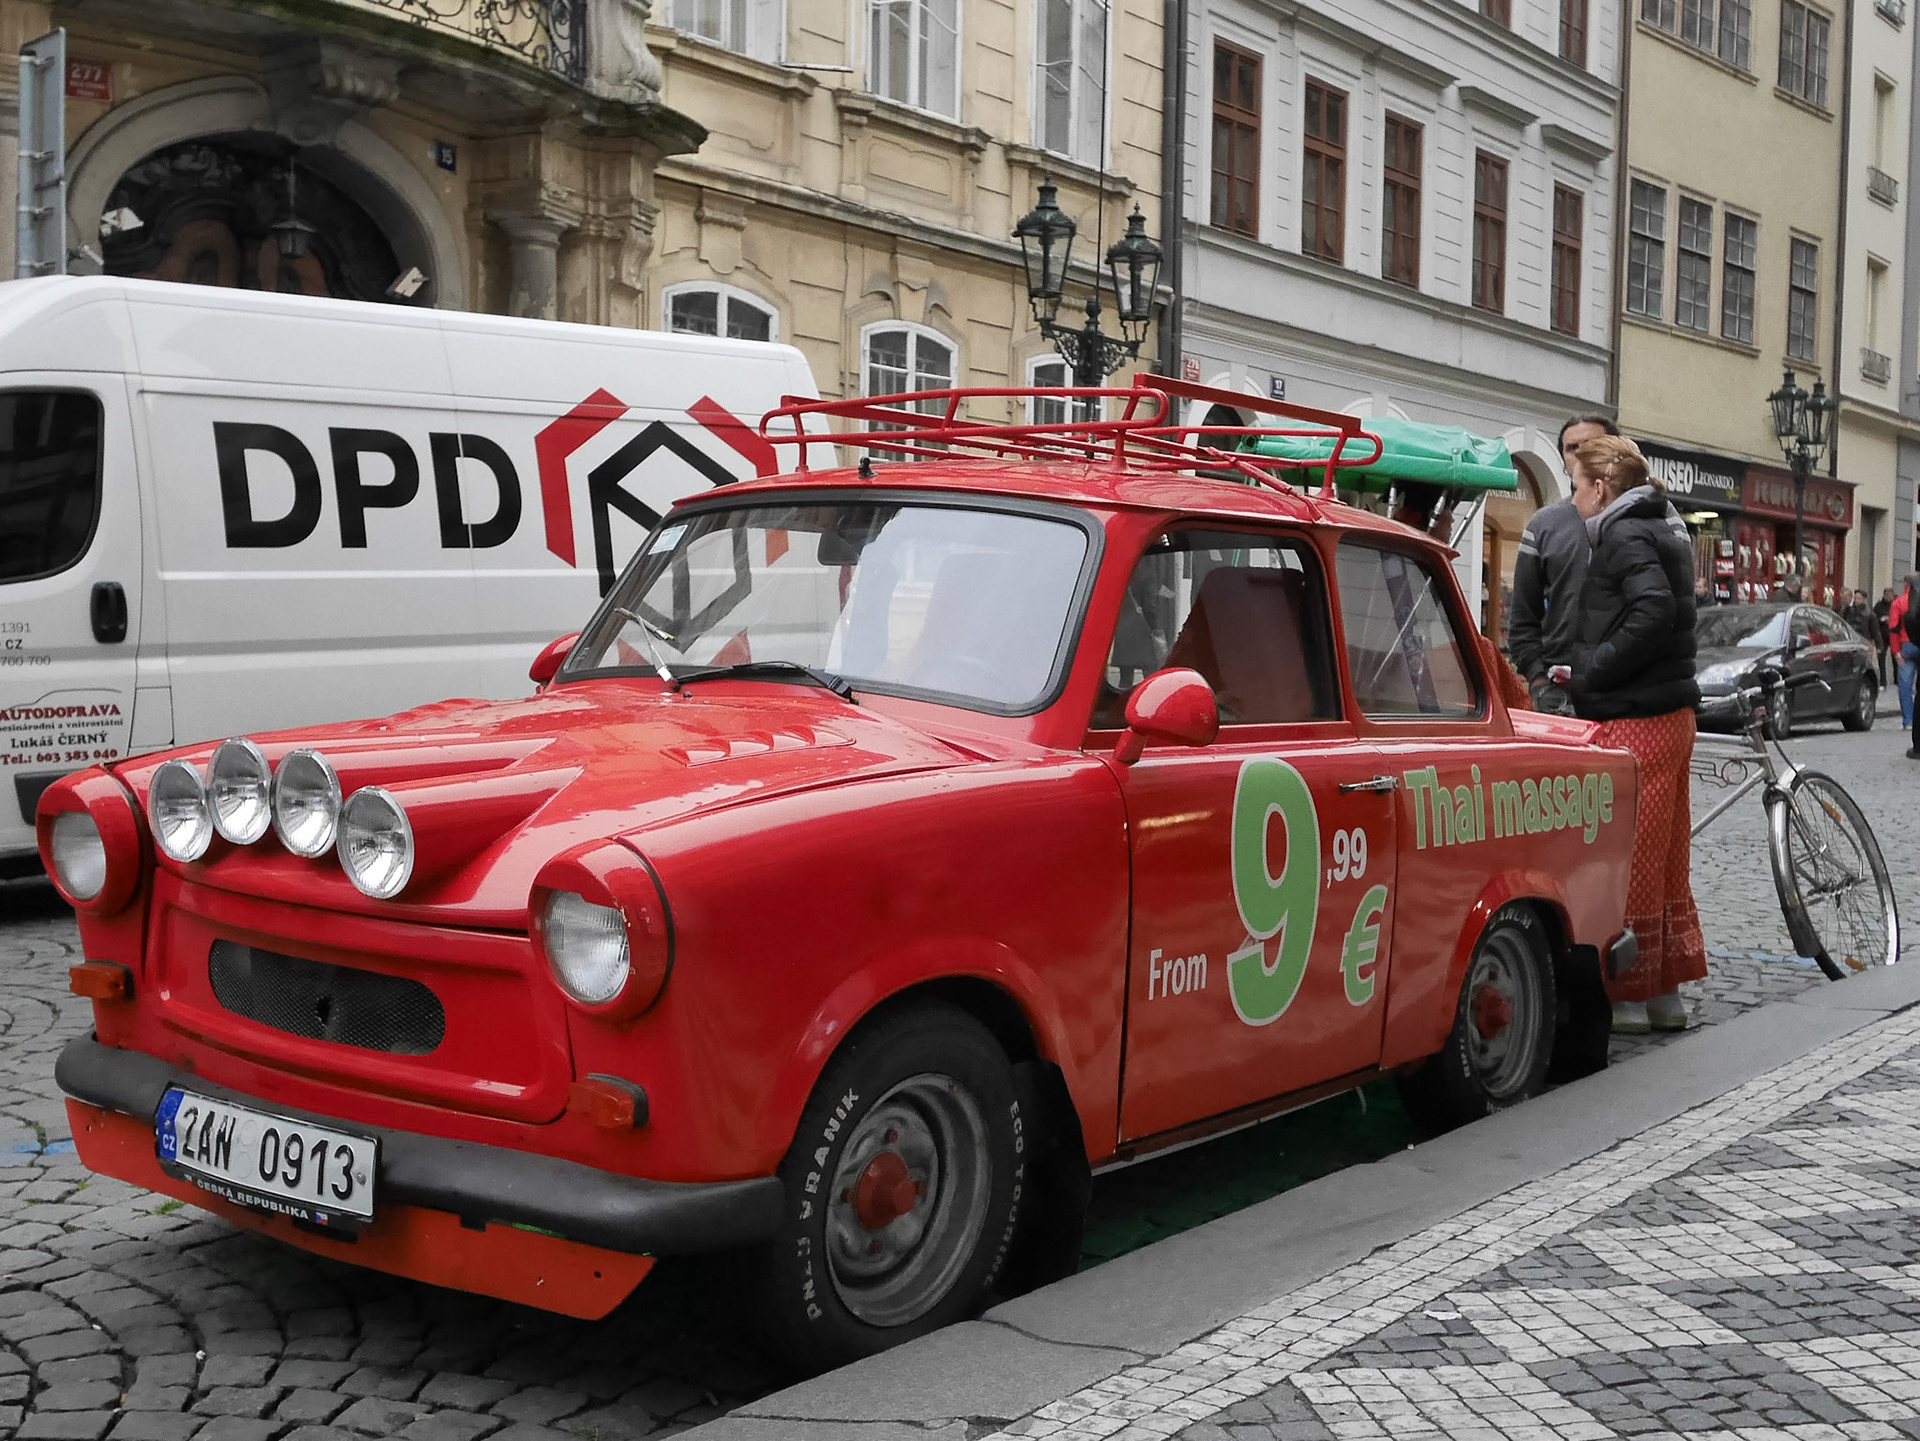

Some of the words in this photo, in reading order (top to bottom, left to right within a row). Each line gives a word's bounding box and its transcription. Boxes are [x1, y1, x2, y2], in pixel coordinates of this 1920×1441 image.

[71, 63, 102, 81] 277
[1649, 455, 1693, 495] MUSEO
[1693, 463, 1735, 490] LEONARDO
[212, 421, 522, 549] DPD
[5, 638, 23, 650] CZ
[28, 654, 52, 666] 700
[0, 705, 121, 721] AUTODOPRAVA
[57, 723, 63, 732] a
[11, 736, 54, 749] Lukáš
[58, 730, 108, 746] ČERNÝ
[36, 752, 61, 764] 603
[64, 750, 89, 763] 383
[93, 748, 118, 760] 040
[1403, 764, 1486, 850] Thai
[1491, 771, 1615, 844] massage
[1148, 948, 1207, 1001] From
[1340, 884, 1388, 1007] €
[1009, 1100, 1024, 1154] ECO
[162, 1133, 176, 1151] CZ
[182, 1106, 236, 1171] 2AN
[259, 1127, 355, 1200] 0913
[237, 1190, 310, 1220] REPUBLIKA
